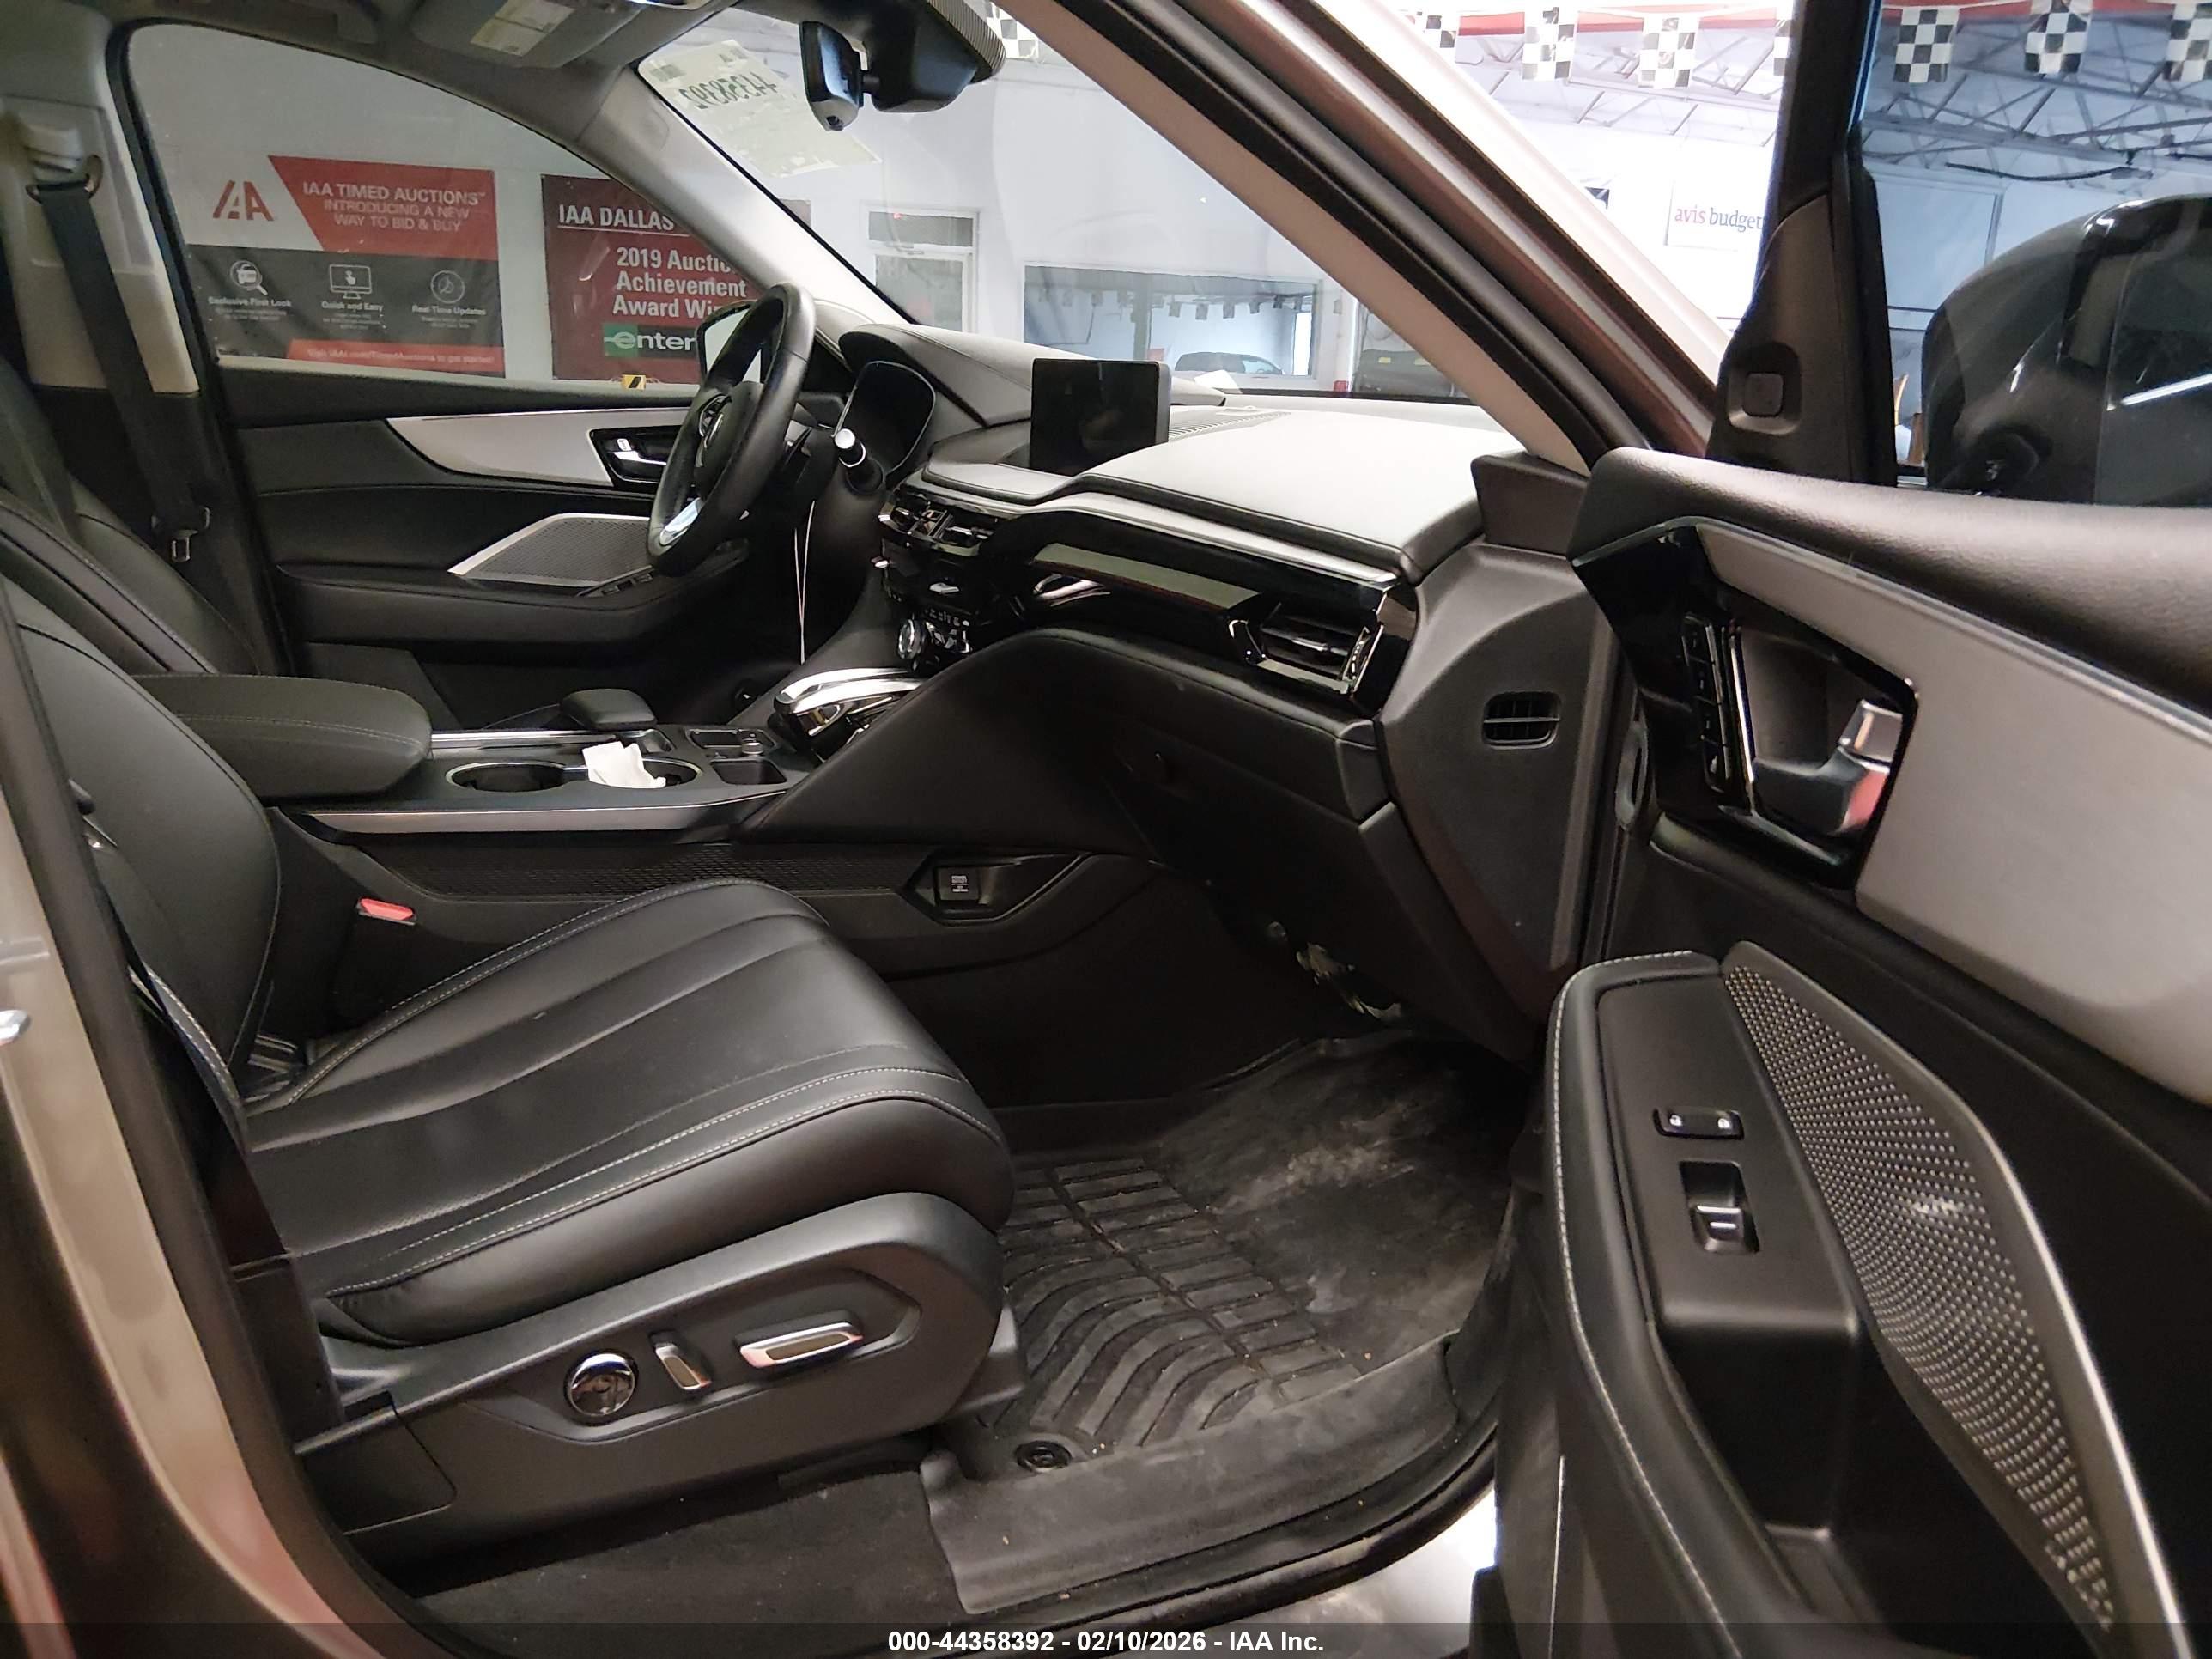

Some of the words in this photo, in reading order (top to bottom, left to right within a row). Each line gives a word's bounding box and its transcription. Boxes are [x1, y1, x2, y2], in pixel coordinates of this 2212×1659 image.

[303, 181, 334, 197] IAA
[336, 183, 389, 200] TIMED
[324, 198, 420, 216] INTRODUCING
[424, 205, 434, 216] A
[437, 206, 470, 219] NEW
[559, 204, 594, 225] IAA
[600, 207, 675, 231] DALLAS
[1674, 204, 1706, 224] avis
[1709, 207, 1763, 233] budget
[333, 211, 365, 226] WAY
[370, 216, 388, 228] TO
[392, 217, 415, 229] BID
[418, 218, 428, 231] &
[433, 219, 461, 232] BUY
[617, 246, 662, 269] 2019
[667, 249, 735, 274] Auctio
[616, 270, 747, 298] Achievement
[612, 295, 679, 318] Award
[684, 298, 725, 319] Wi
